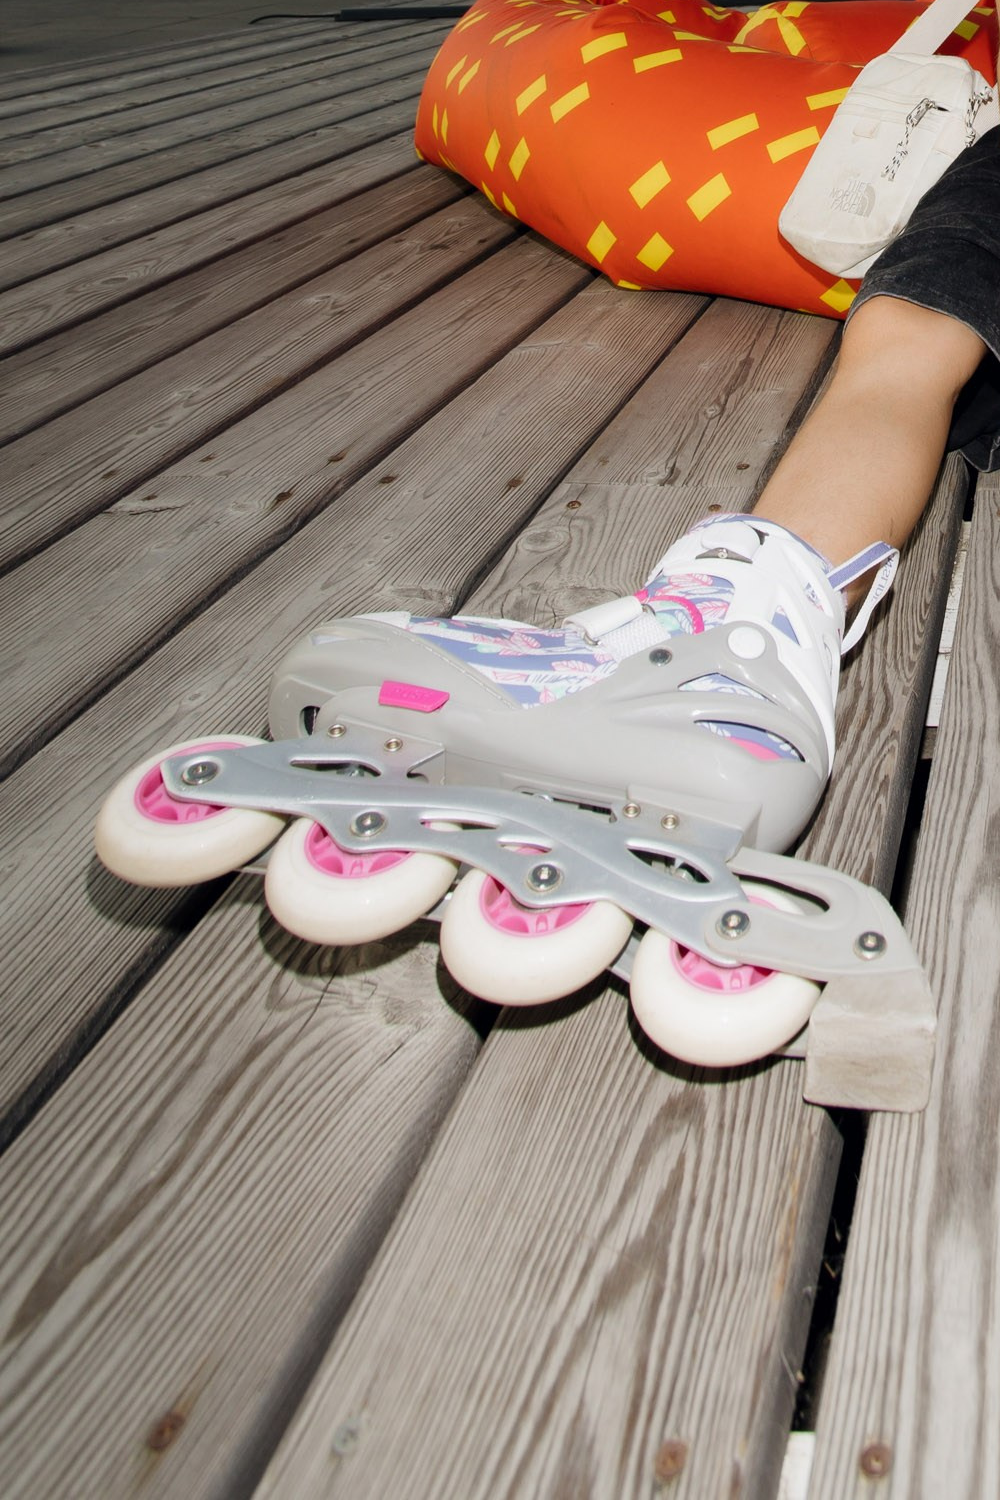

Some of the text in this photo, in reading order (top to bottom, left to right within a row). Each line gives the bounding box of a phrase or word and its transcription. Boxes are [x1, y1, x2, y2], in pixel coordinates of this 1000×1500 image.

[847, 180, 866, 193] THE
[828, 188, 863, 204] NORTH
[830, 198, 859, 214] FACE
